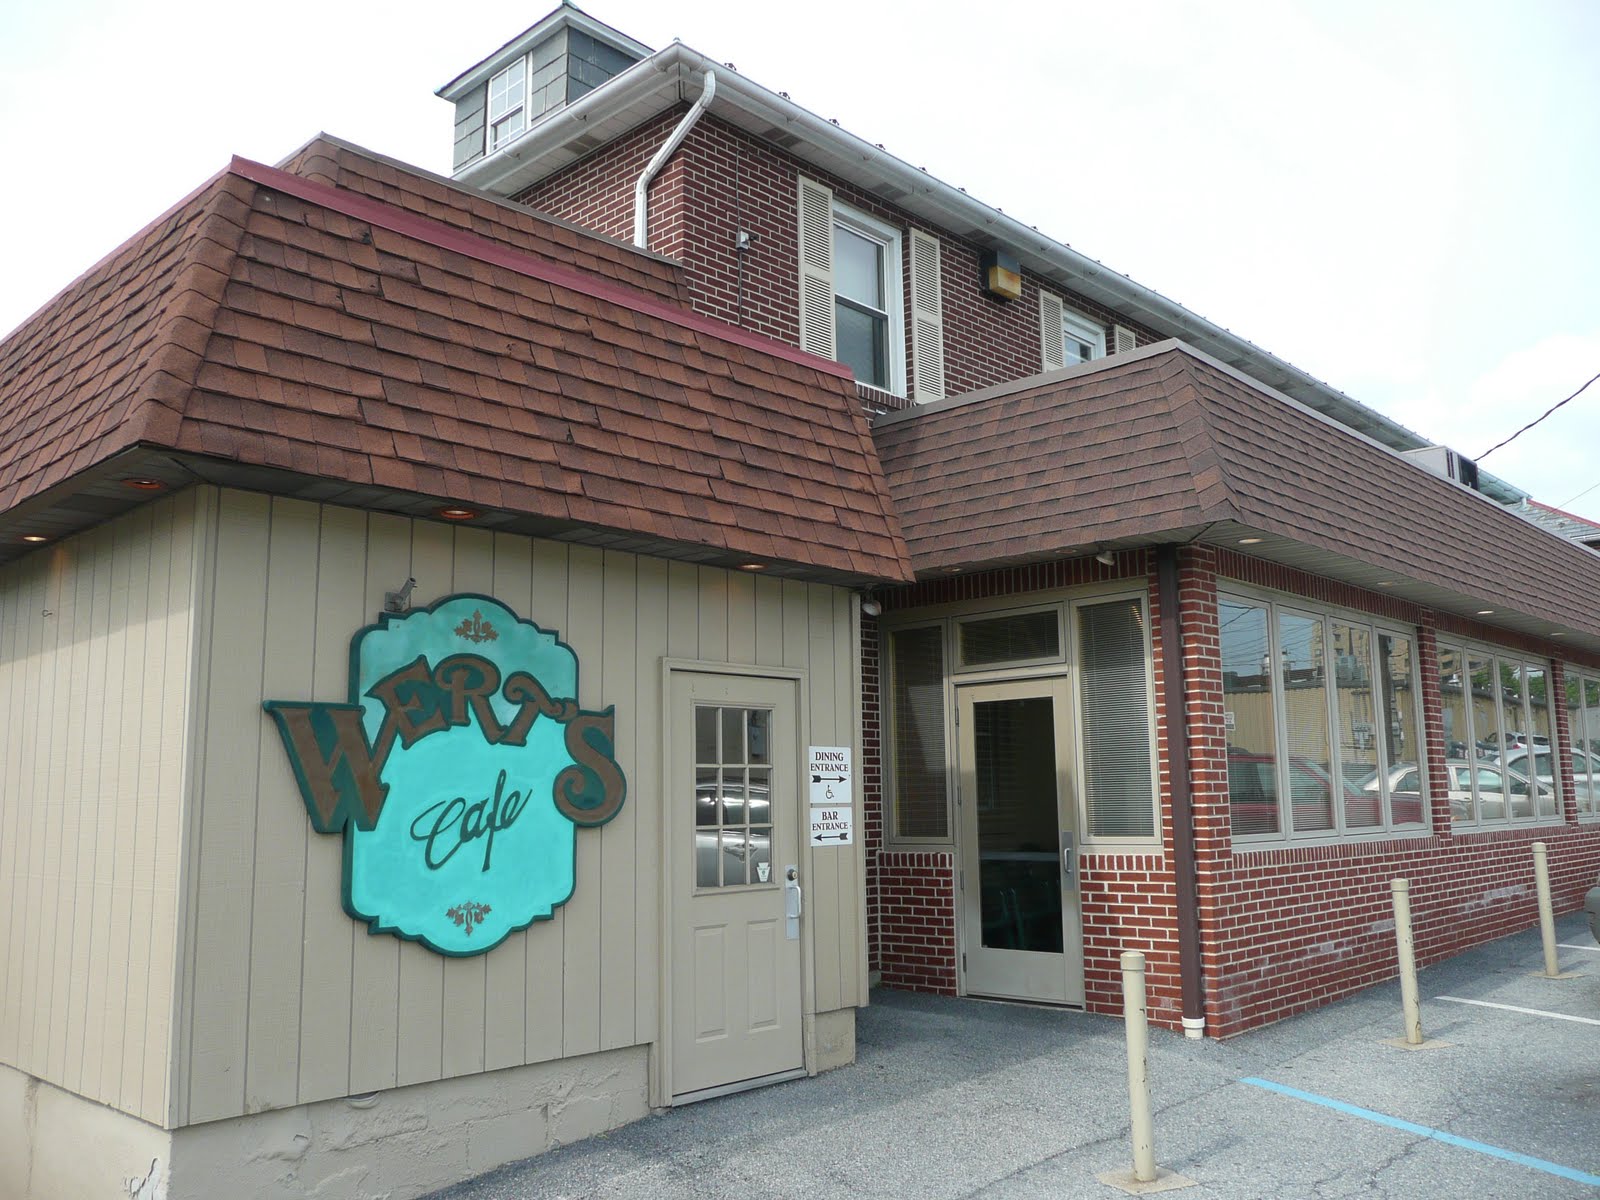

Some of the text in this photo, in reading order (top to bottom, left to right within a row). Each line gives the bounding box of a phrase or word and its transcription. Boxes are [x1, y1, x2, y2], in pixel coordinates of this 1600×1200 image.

[815, 752, 844, 761] DINING
[810, 763, 849, 772] ENTRANCE
[410, 769, 532, 872] Cafe
[822, 811, 838, 821] BAR
[812, 822, 848, 831] ENTRANCE
